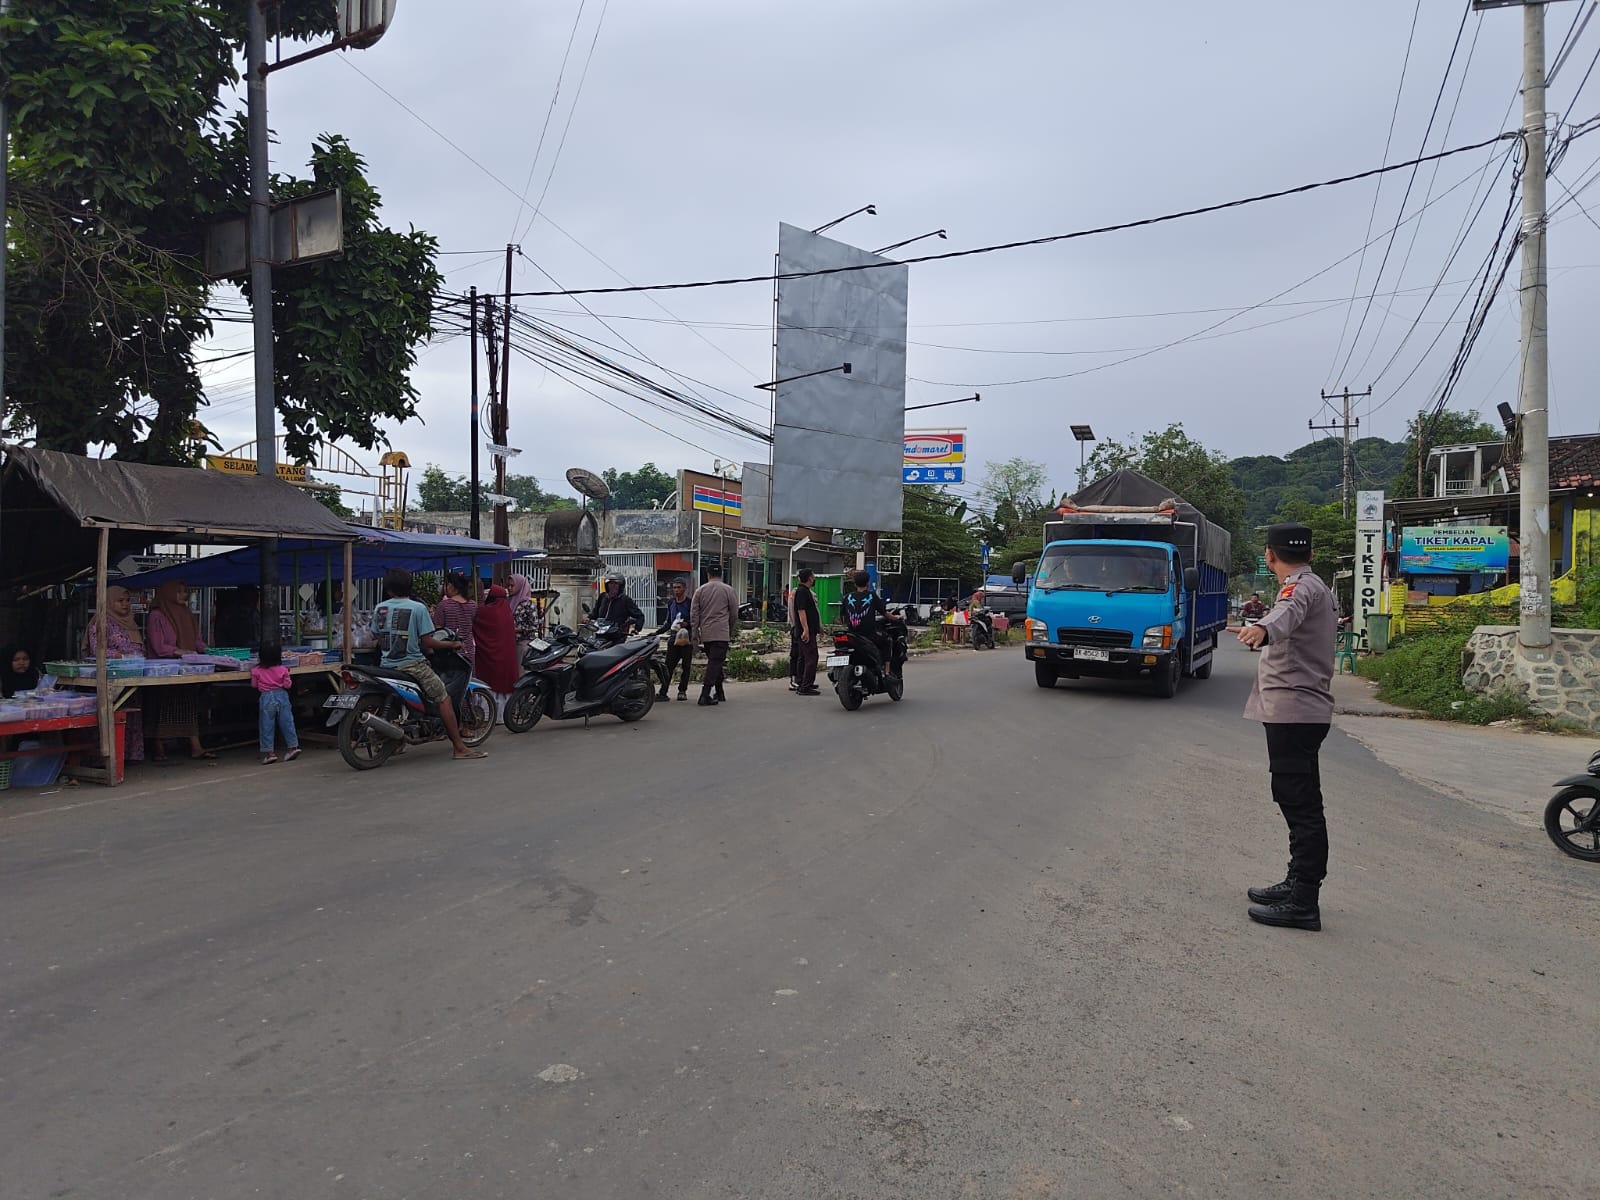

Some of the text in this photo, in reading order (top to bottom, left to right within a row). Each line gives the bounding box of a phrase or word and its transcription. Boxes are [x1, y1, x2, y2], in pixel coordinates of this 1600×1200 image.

[223, 461, 306, 475] SELAMA TANG
[1415, 537, 1495, 545] TIKET KAPAL
[1362, 534, 1376, 584] TIKET
